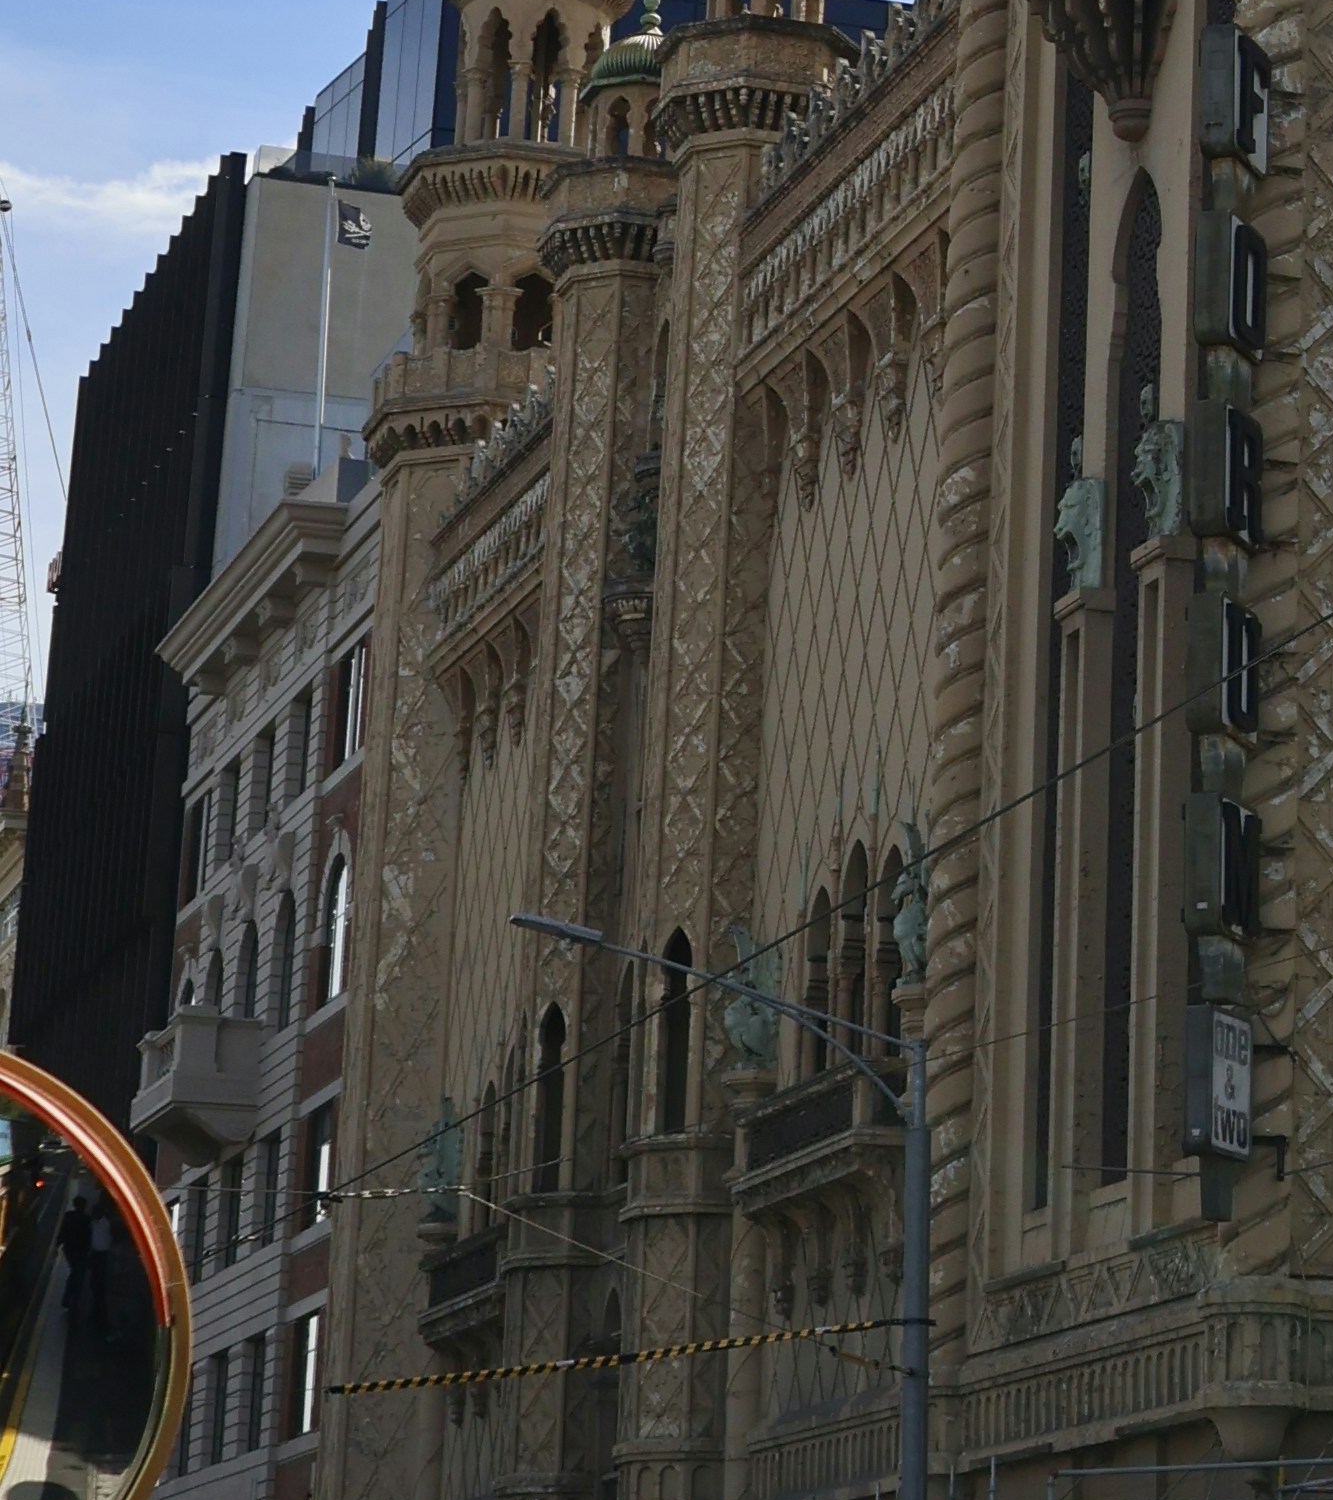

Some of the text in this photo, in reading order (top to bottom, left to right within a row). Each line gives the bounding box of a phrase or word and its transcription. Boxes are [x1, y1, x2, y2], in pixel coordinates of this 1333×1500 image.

[1214, 1013, 1250, 1067] one
[1224, 1068, 1237, 1101] &
[1212, 1102, 1250, 1151] two
